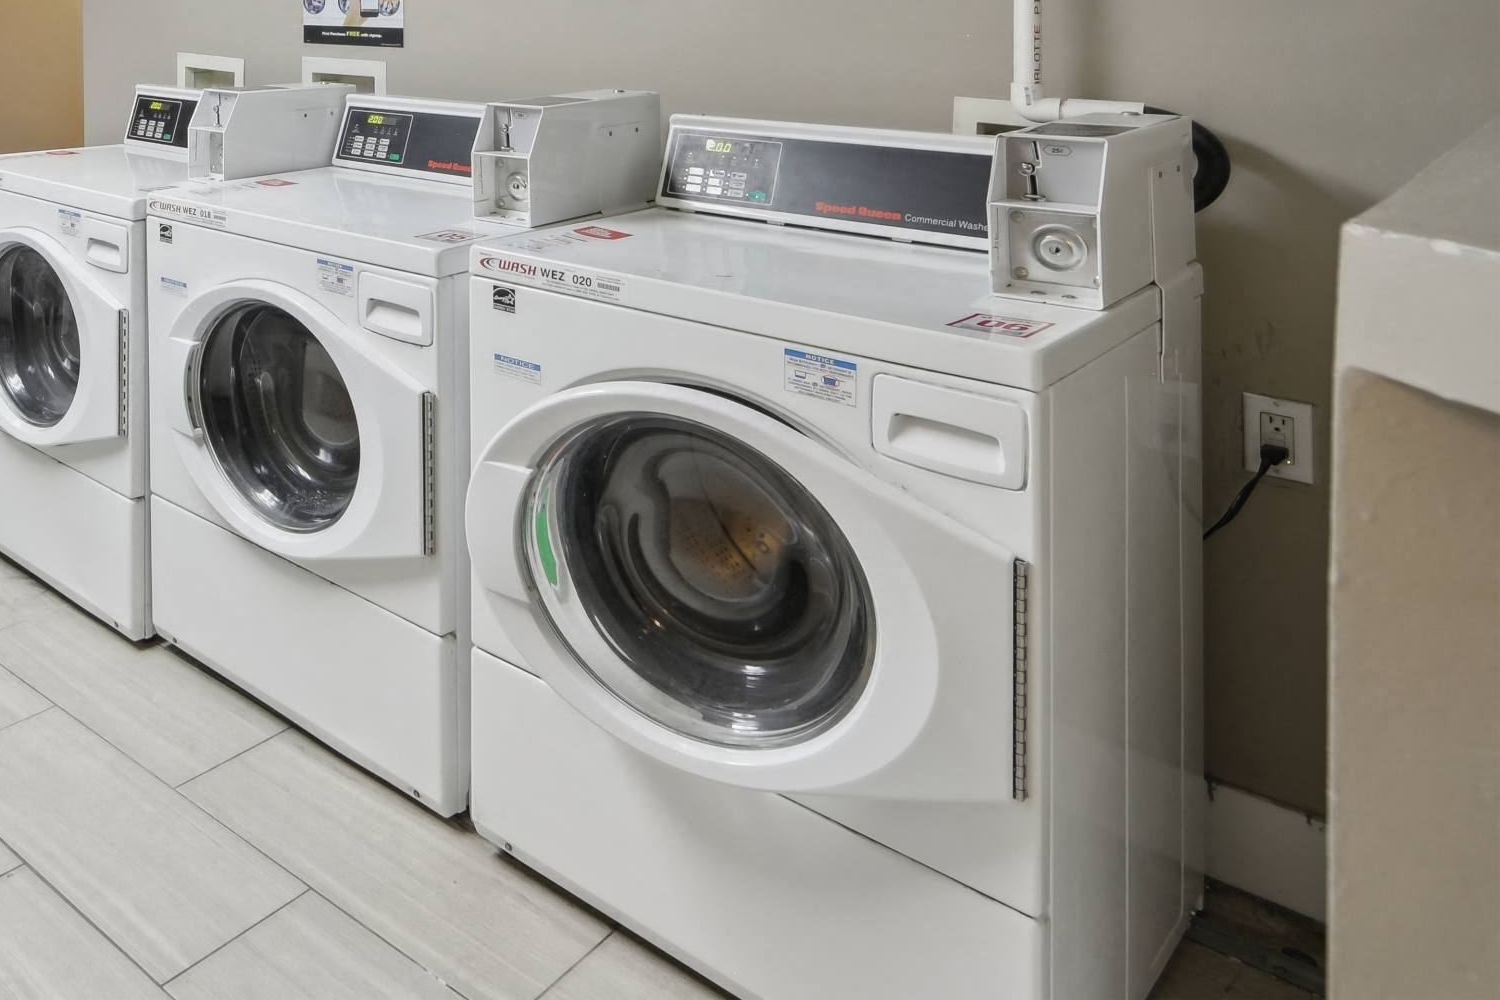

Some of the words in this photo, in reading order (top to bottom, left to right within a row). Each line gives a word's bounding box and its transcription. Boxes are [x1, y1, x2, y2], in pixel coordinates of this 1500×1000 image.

[160, 202, 181, 213] WASH
[183, 206, 197, 216] WEZ
[815, 200, 857, 215] Speed
[859, 204, 901, 220] Queen
[904, 213, 956, 228] Commercial
[959, 219, 988, 232] Washe
[498, 259, 537, 276] WASH
[540, 267, 565, 282] WEZ
[572, 274, 592, 287] 020
[977, 319, 1032, 331] 06
[500, 356, 532, 369] NOTICE
[805, 353, 836, 365] NOTICE
